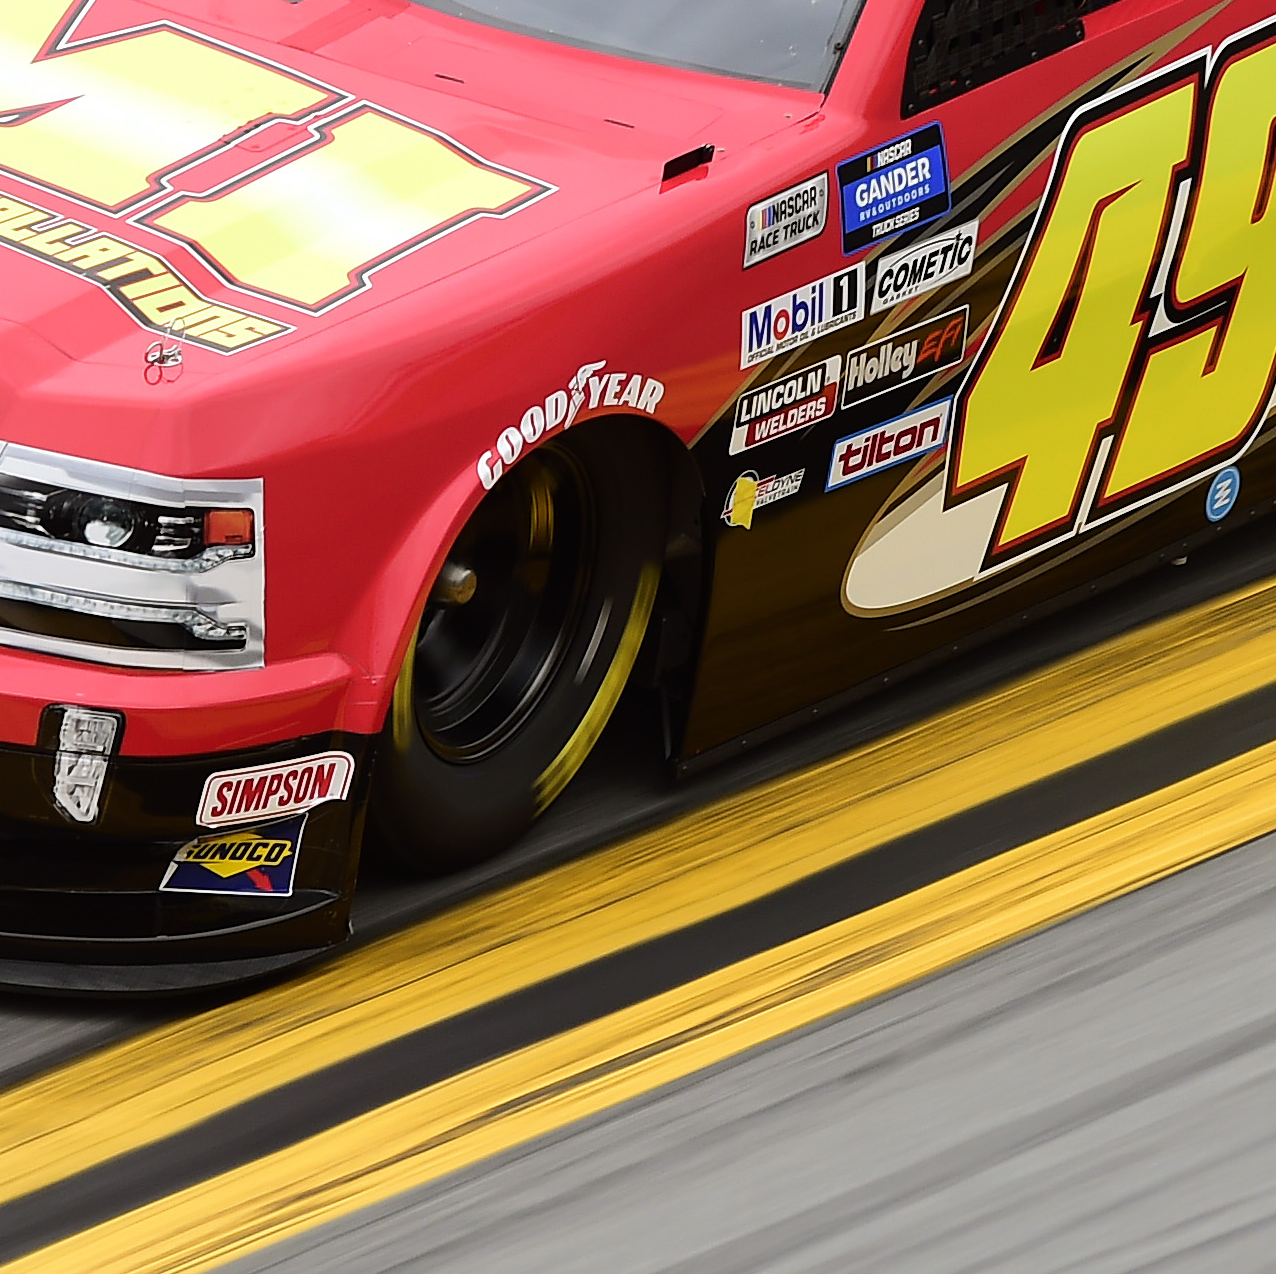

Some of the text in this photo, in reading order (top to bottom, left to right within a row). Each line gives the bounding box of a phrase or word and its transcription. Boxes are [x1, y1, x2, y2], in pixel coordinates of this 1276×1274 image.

[878, 138, 912, 167] NASCAR
[771, 185, 817, 225] NASCAR
[855, 157, 931, 207] GANDER
[749, 210, 820, 256] RACE TRUCK
[878, 233, 973, 299] COMETIC
[747, 348, 774, 364] OFFICIAL
[775, 335, 798, 352] MOTOR
[816, 311, 857, 334] LUBRICANTS
[748, 281, 824, 354] Mobil
[847, 339, 919, 392] Holley
[740, 368, 823, 423] LINCOLN
[754, 395, 827, 441] WELDERS
[476, 360, 665, 491] GOODYEAR
[838, 415, 941, 477] tilton
[210, 762, 337, 817] SIMPSON
